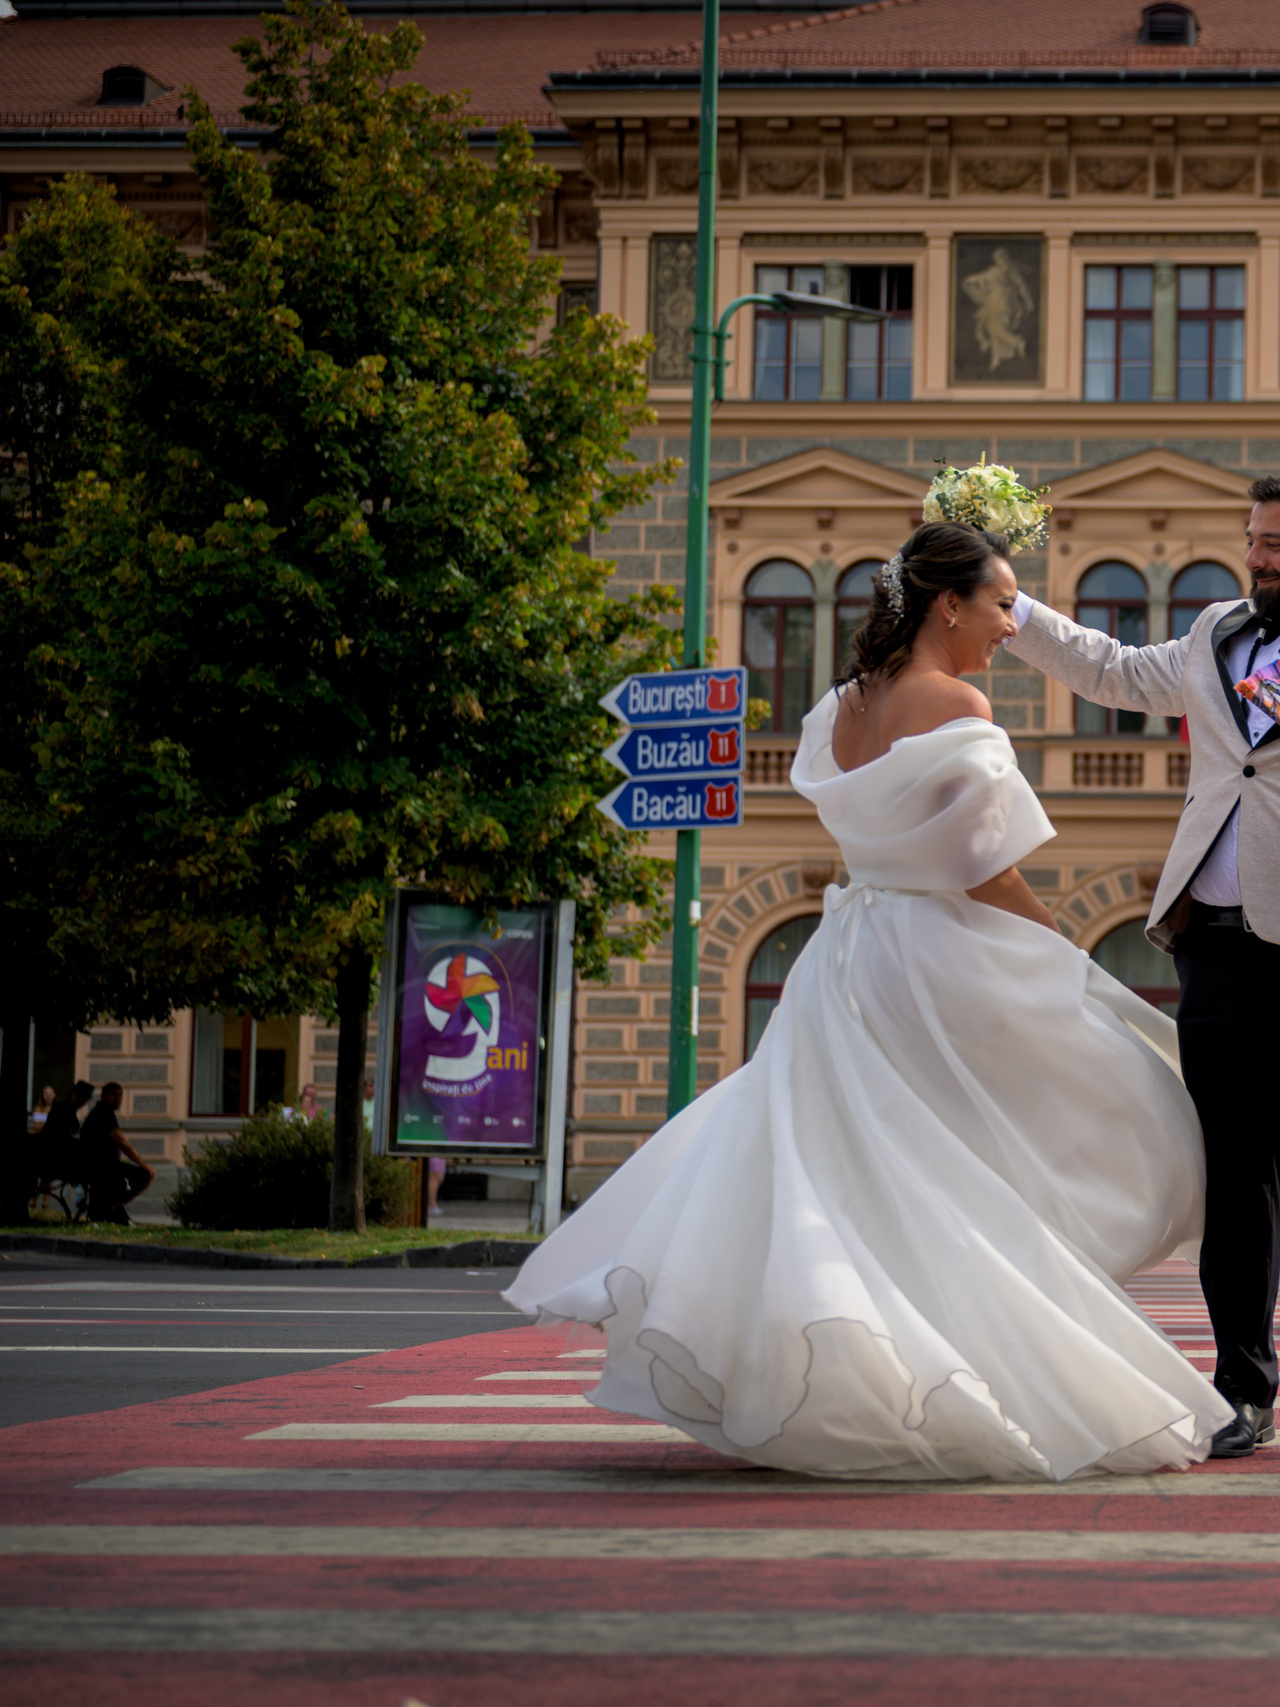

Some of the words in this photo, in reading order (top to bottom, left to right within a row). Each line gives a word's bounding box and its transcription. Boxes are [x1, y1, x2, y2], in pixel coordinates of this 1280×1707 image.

[628, 676, 706, 717] București
[637, 732, 704, 769] Buzău
[718, 737, 729, 757] 11
[632, 786, 701, 822] Bacău
[715, 791, 727, 811] 11
[487, 1041, 528, 1071] ani
